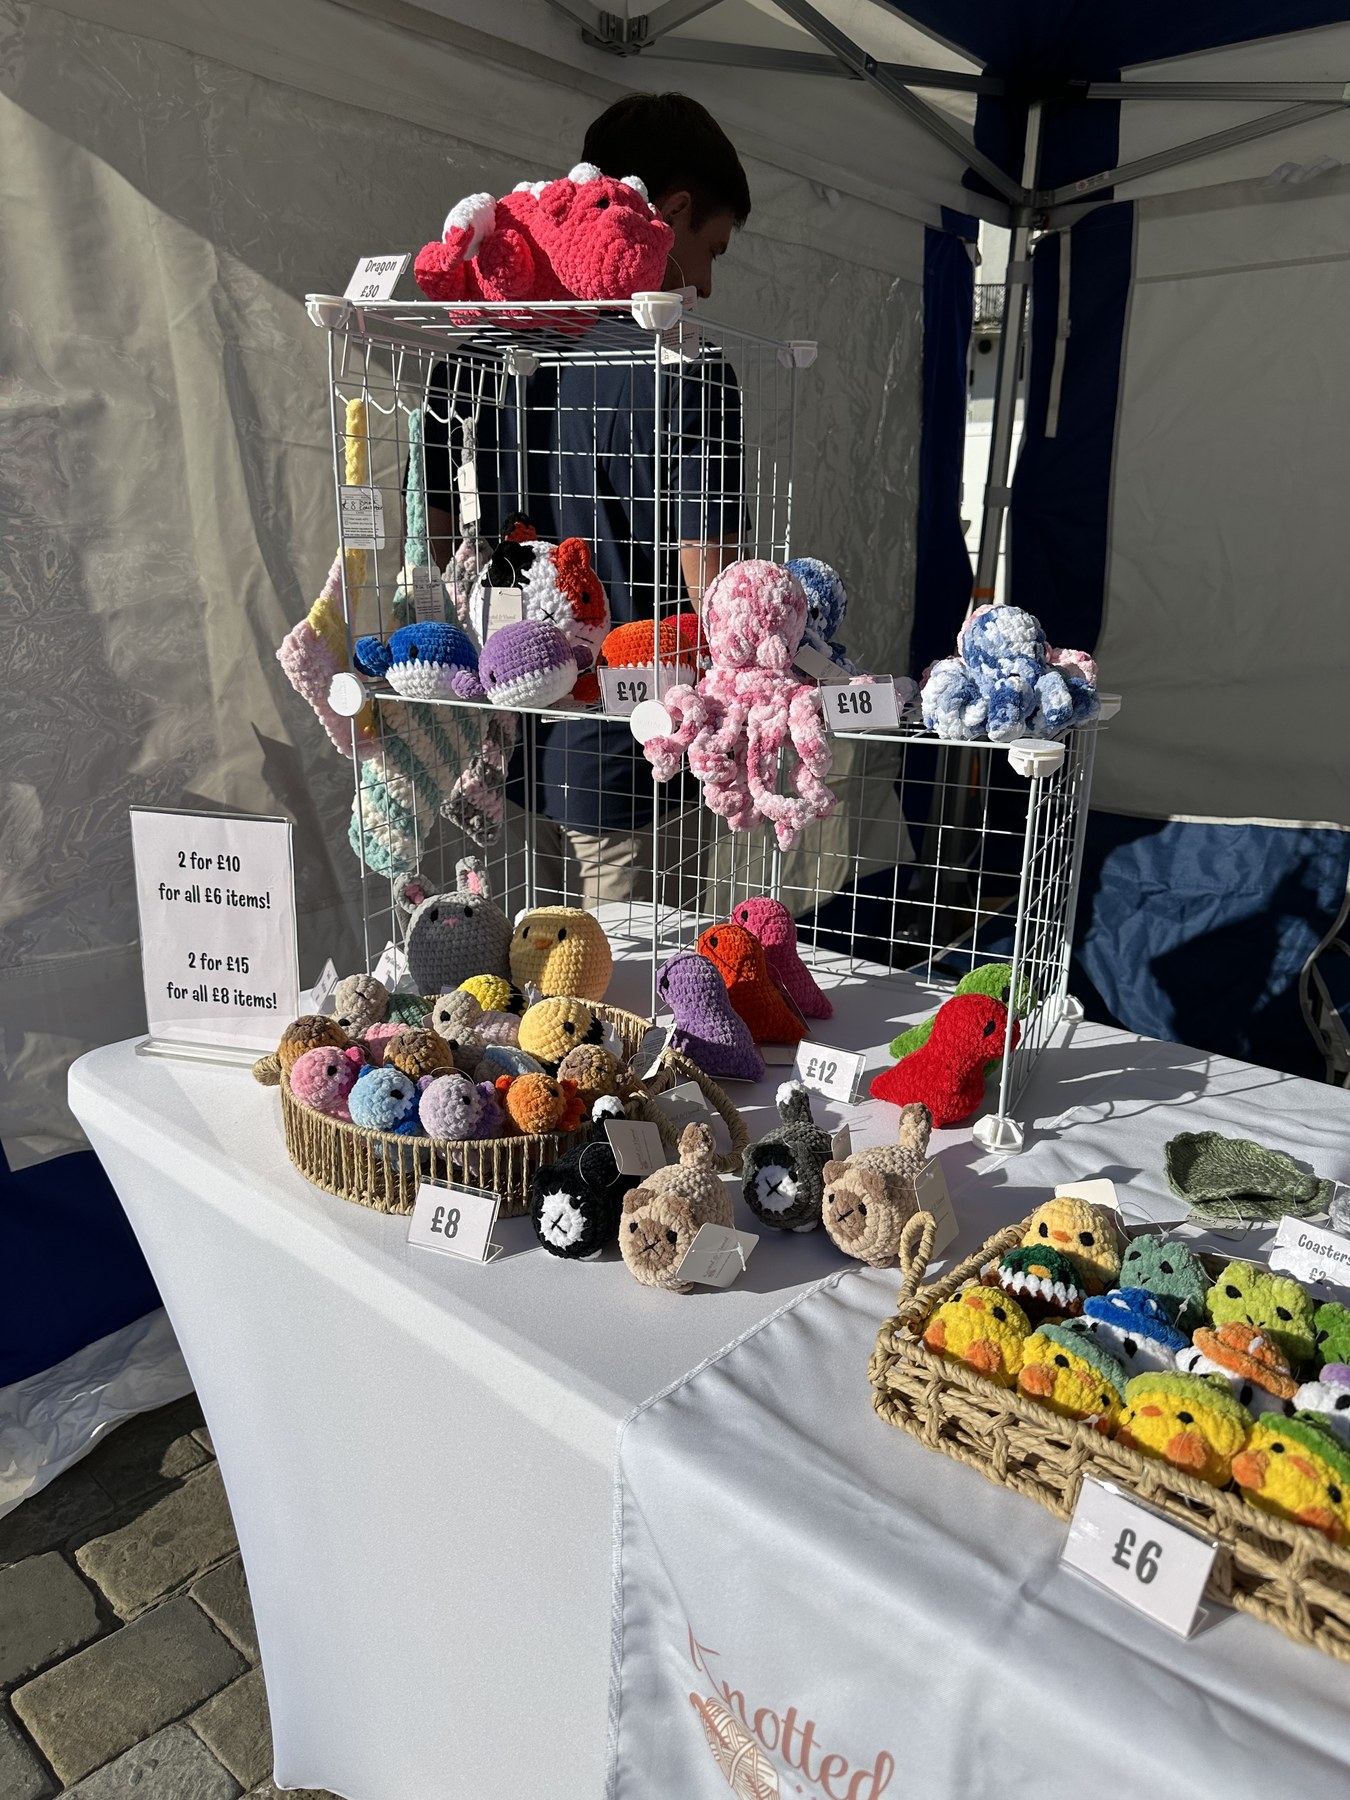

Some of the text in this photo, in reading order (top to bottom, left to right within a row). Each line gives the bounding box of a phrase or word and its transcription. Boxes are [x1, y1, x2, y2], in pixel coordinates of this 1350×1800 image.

[365, 260, 397, 275] Dragon
[360, 284, 380, 298] £30
[617, 681, 649, 702] £12
[837, 690, 873, 715] £18
[178, 851, 241, 872] 2 for £10
[158, 883, 271, 909] for all £6 items!
[188, 952, 250, 974] 2 for £15
[167, 982, 278, 1010] for all £8 items!
[805, 1057, 838, 1085] £12
[430, 1205, 461, 1239] £8
[1298, 1233, 1350, 1266] Coasters
[1111, 1527, 1163, 1584] £6
